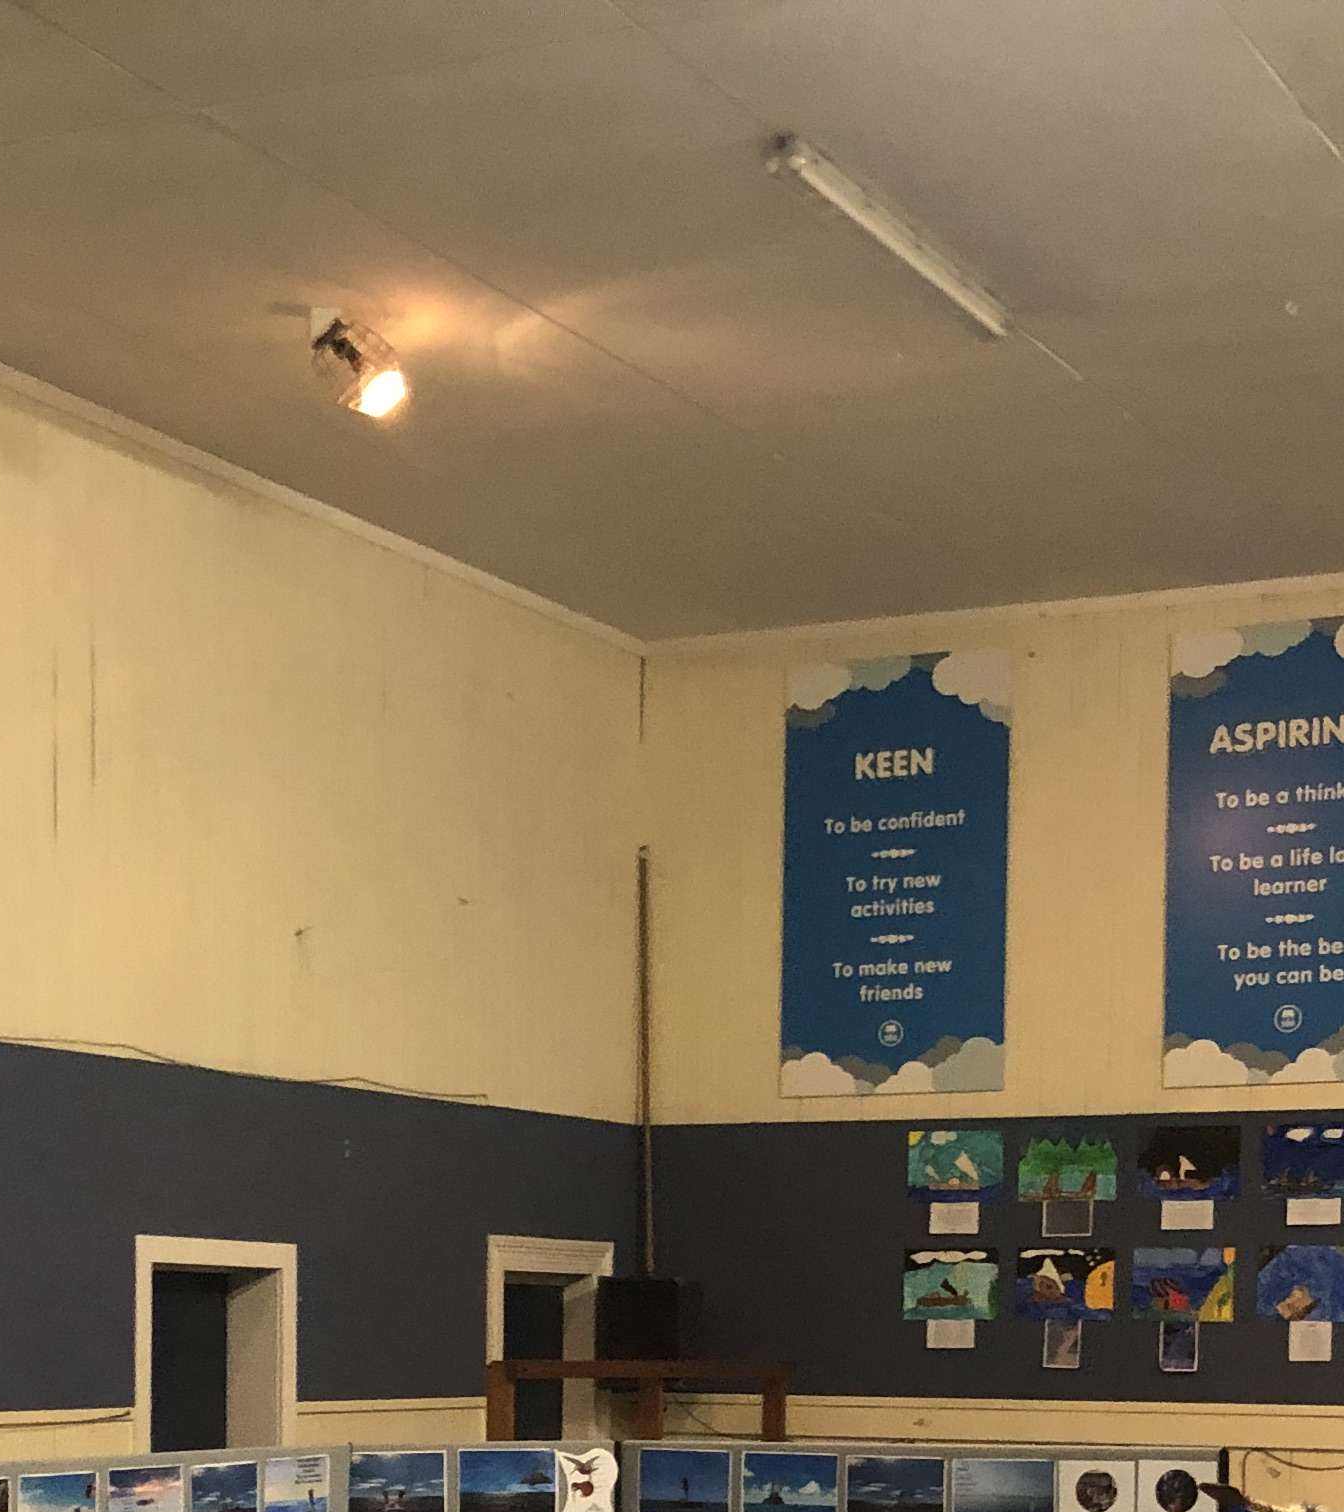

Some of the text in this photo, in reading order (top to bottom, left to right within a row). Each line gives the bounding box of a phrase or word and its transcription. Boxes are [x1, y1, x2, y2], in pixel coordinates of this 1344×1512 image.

[854, 747, 935, 780] KEEN
[1216, 792, 1239, 810] To
[1244, 789, 1270, 807] be
[1275, 790, 1289, 805] a
[824, 809, 966, 834] To be confident
[1210, 855, 1233, 872] To
[1238, 852, 1264, 870] be
[1270, 853, 1284, 868] a
[1289, 847, 1322, 866] life
[846, 872, 941, 895] To try new
[1254, 875, 1327, 896] learner
[851, 898, 935, 919] activities
[1217, 944, 1240, 961] To
[1246, 941, 1272, 959] be
[1278, 939, 1310, 957] the
[833, 958, 952, 978] To make new
[1233, 964, 1344, 990] you can be
[859, 982, 923, 1002] friends
